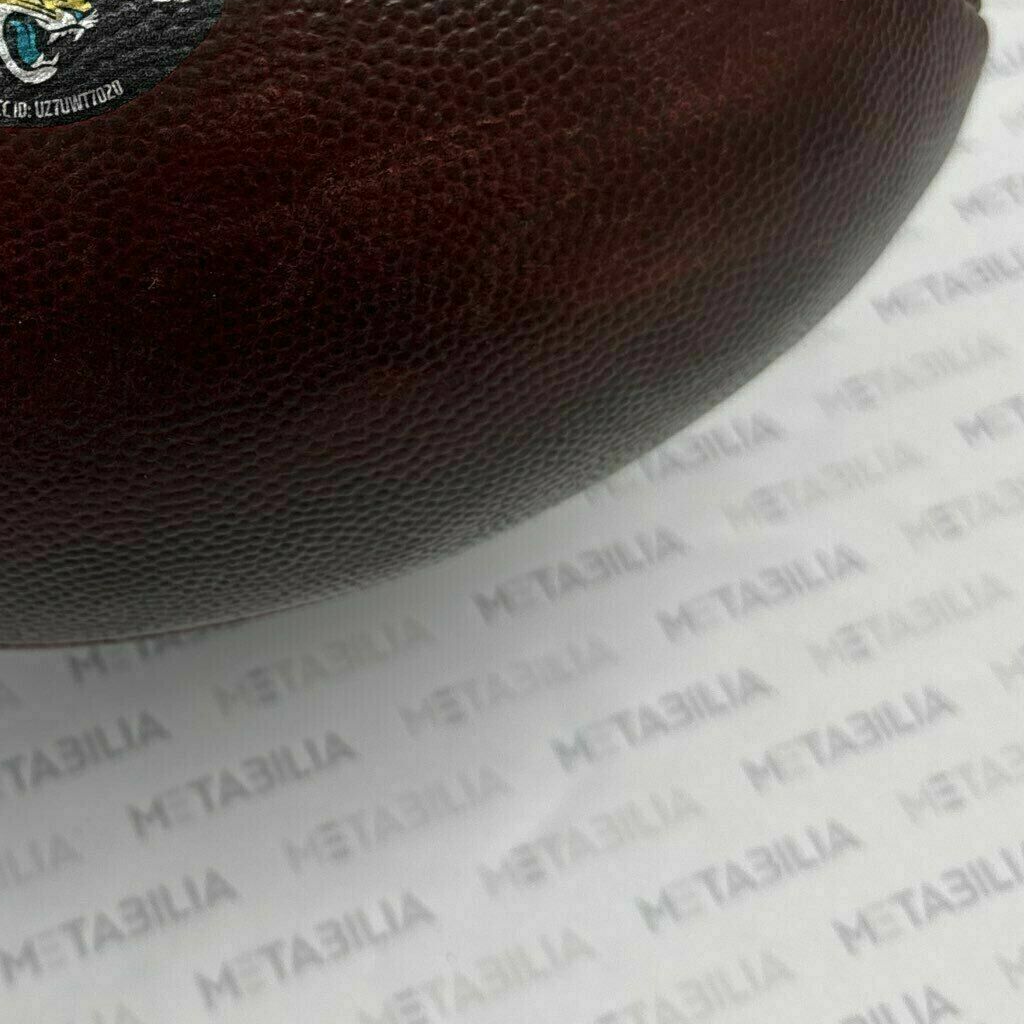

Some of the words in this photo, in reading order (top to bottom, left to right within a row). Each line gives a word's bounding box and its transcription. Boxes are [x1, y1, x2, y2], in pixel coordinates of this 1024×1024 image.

[13, 101, 32, 118] ID:
[126, 730, 360, 842] METABILIA
[634, 817, 864, 934] METABILIA
[831, 841, 1024, 956] METABILI
[193, 891, 436, 1011] METABILIA
